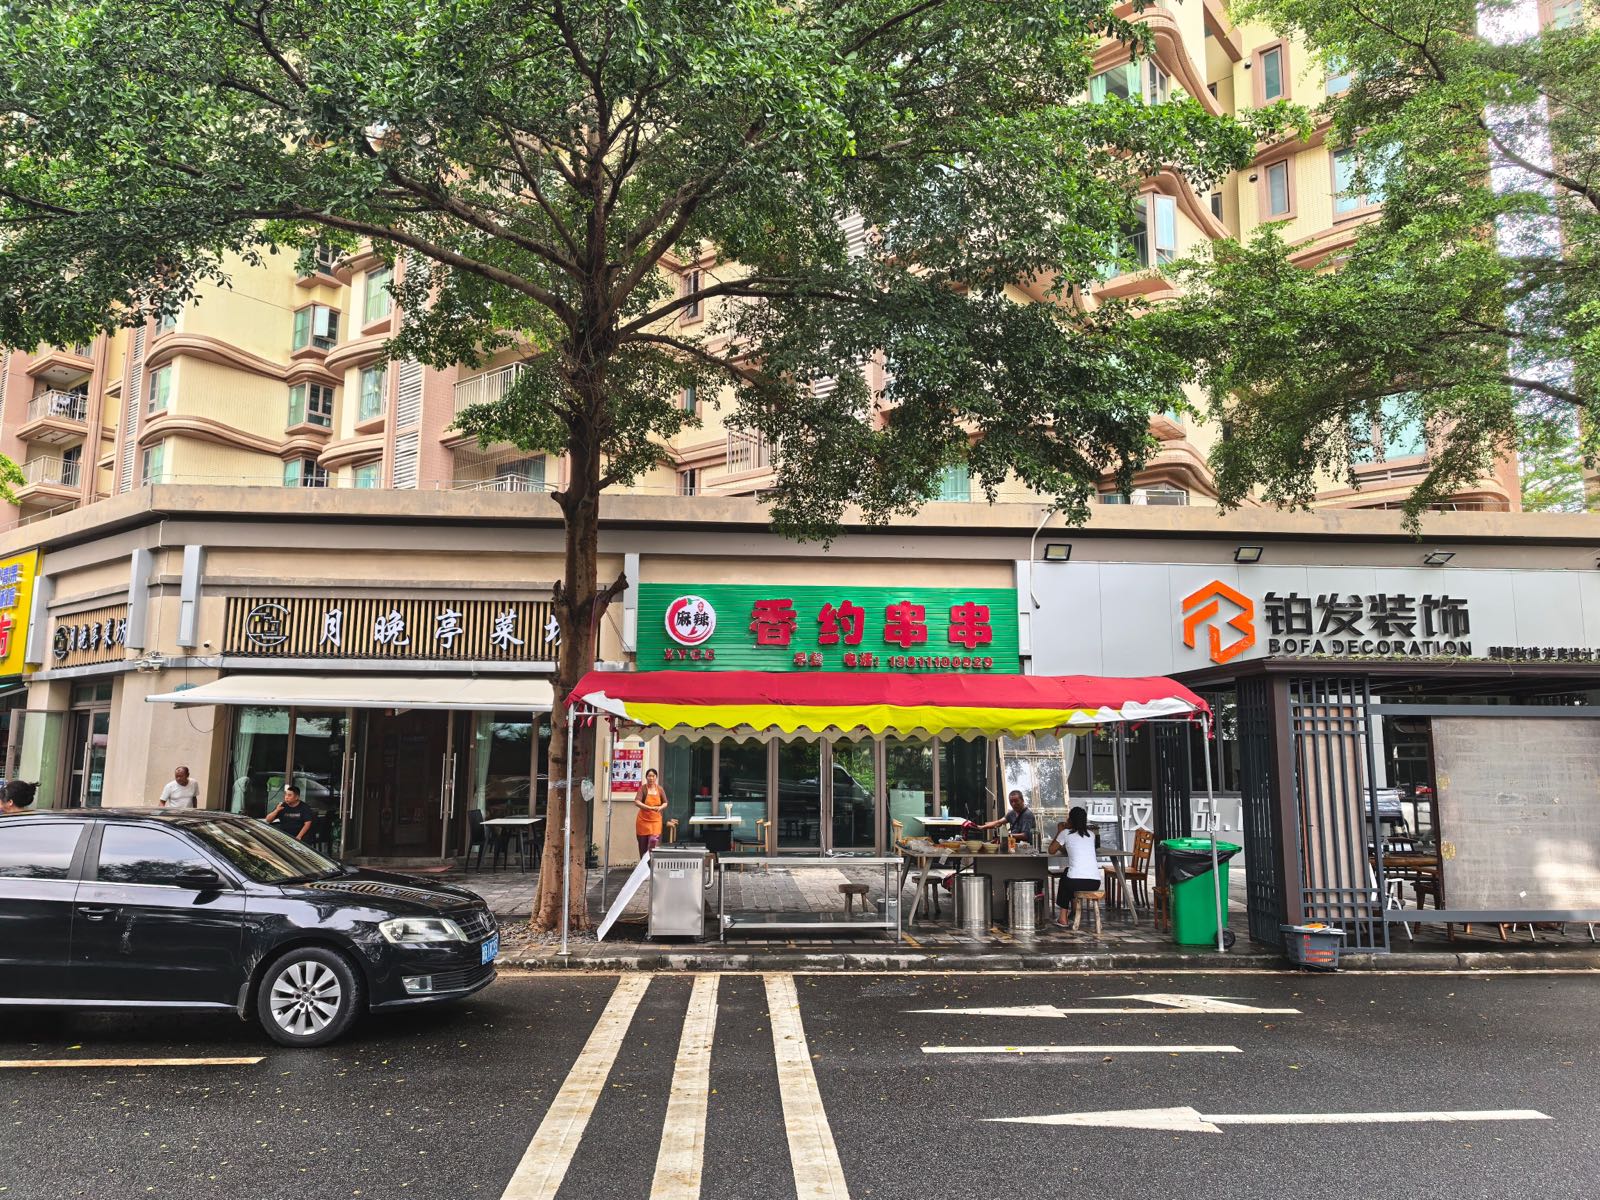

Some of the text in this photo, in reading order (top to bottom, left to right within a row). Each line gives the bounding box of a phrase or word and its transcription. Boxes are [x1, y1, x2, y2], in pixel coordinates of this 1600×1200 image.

[676, 610, 710, 627] 麻辣
[749, 598, 992, 648] 香约串串
[1265, 592, 1471, 637] 铂发装饰
[1268, 638, 1473, 656] BOFA DECORATION
